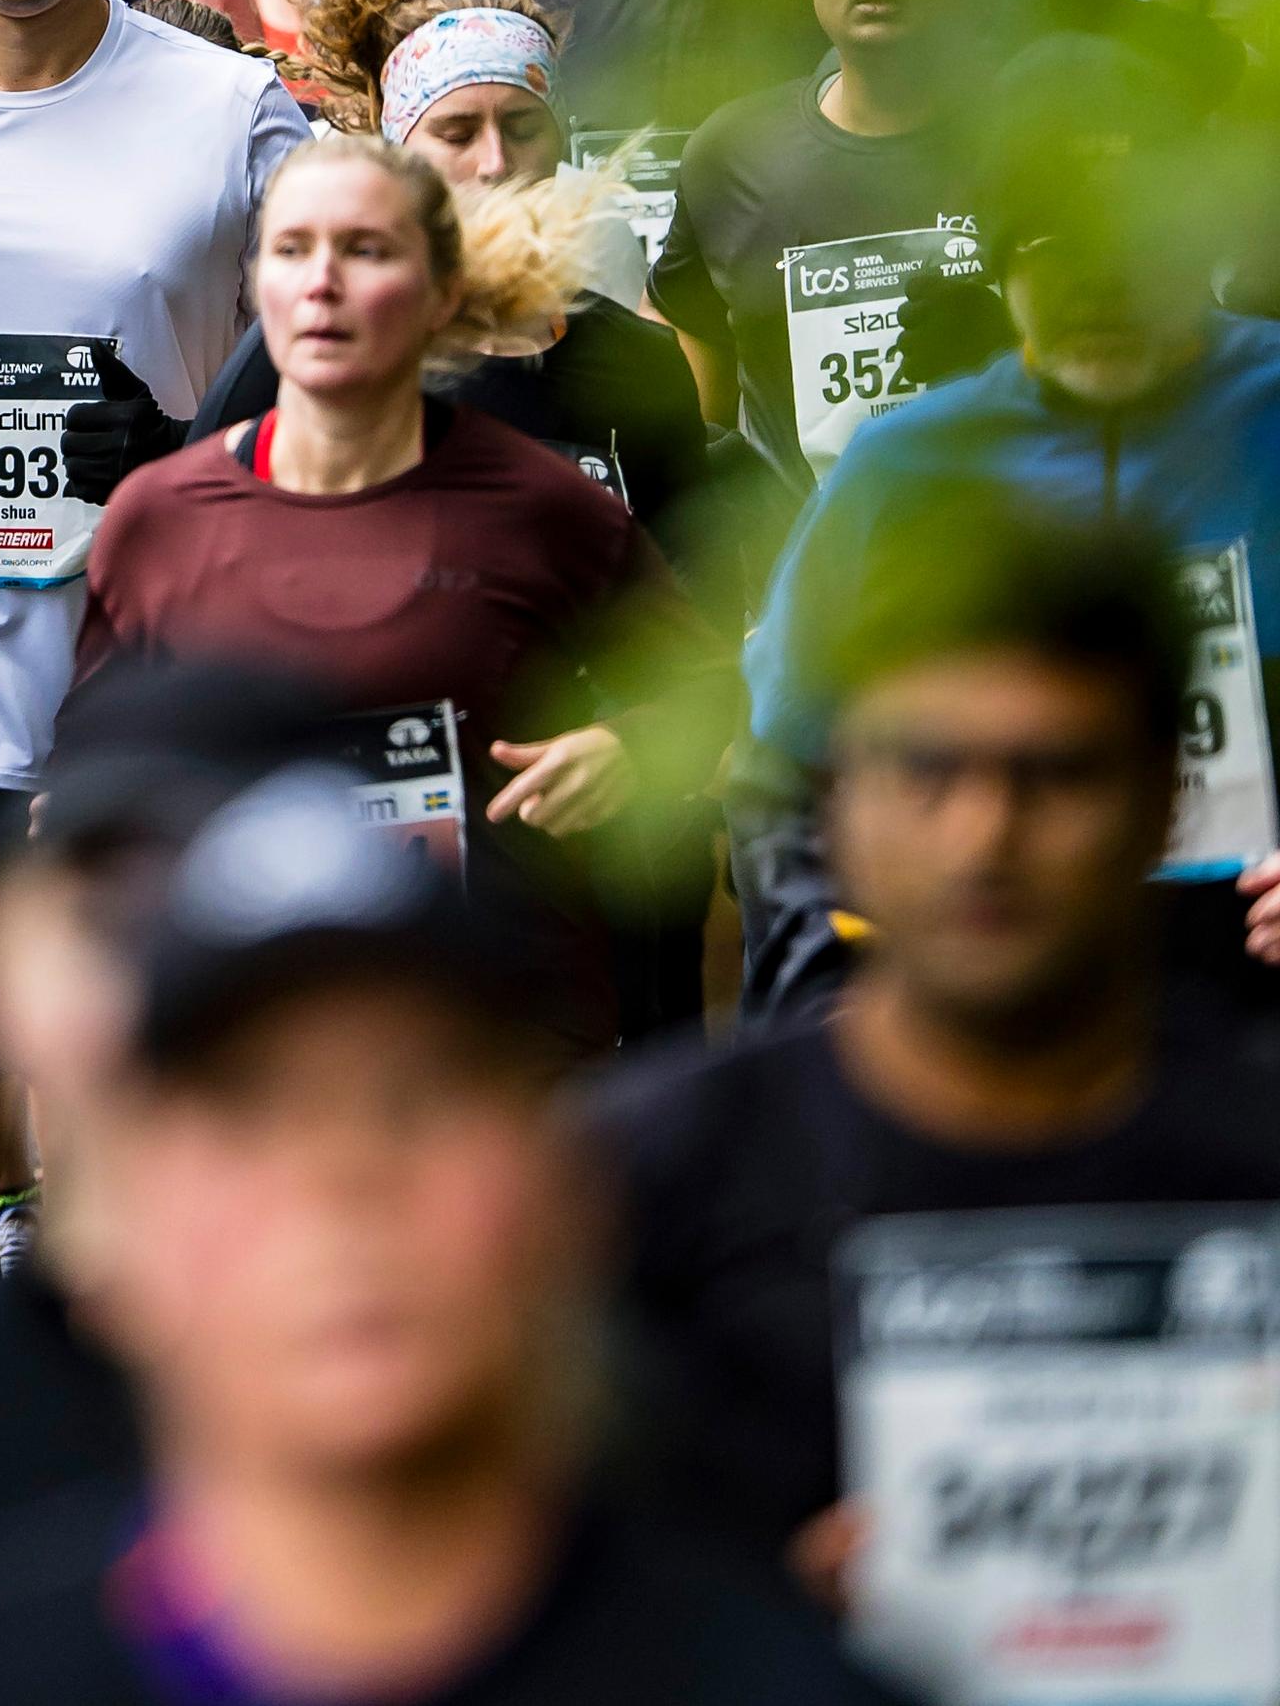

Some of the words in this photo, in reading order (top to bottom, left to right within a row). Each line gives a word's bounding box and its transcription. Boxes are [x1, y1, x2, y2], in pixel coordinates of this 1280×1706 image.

[853, 254, 884, 266] TATA
[854, 259, 924, 277] CONSULTANCY
[940, 260, 983, 277] TATA
[799, 265, 849, 296] tcs
[854, 274, 900, 290] SERVICES
[820, 347, 928, 405] 352
